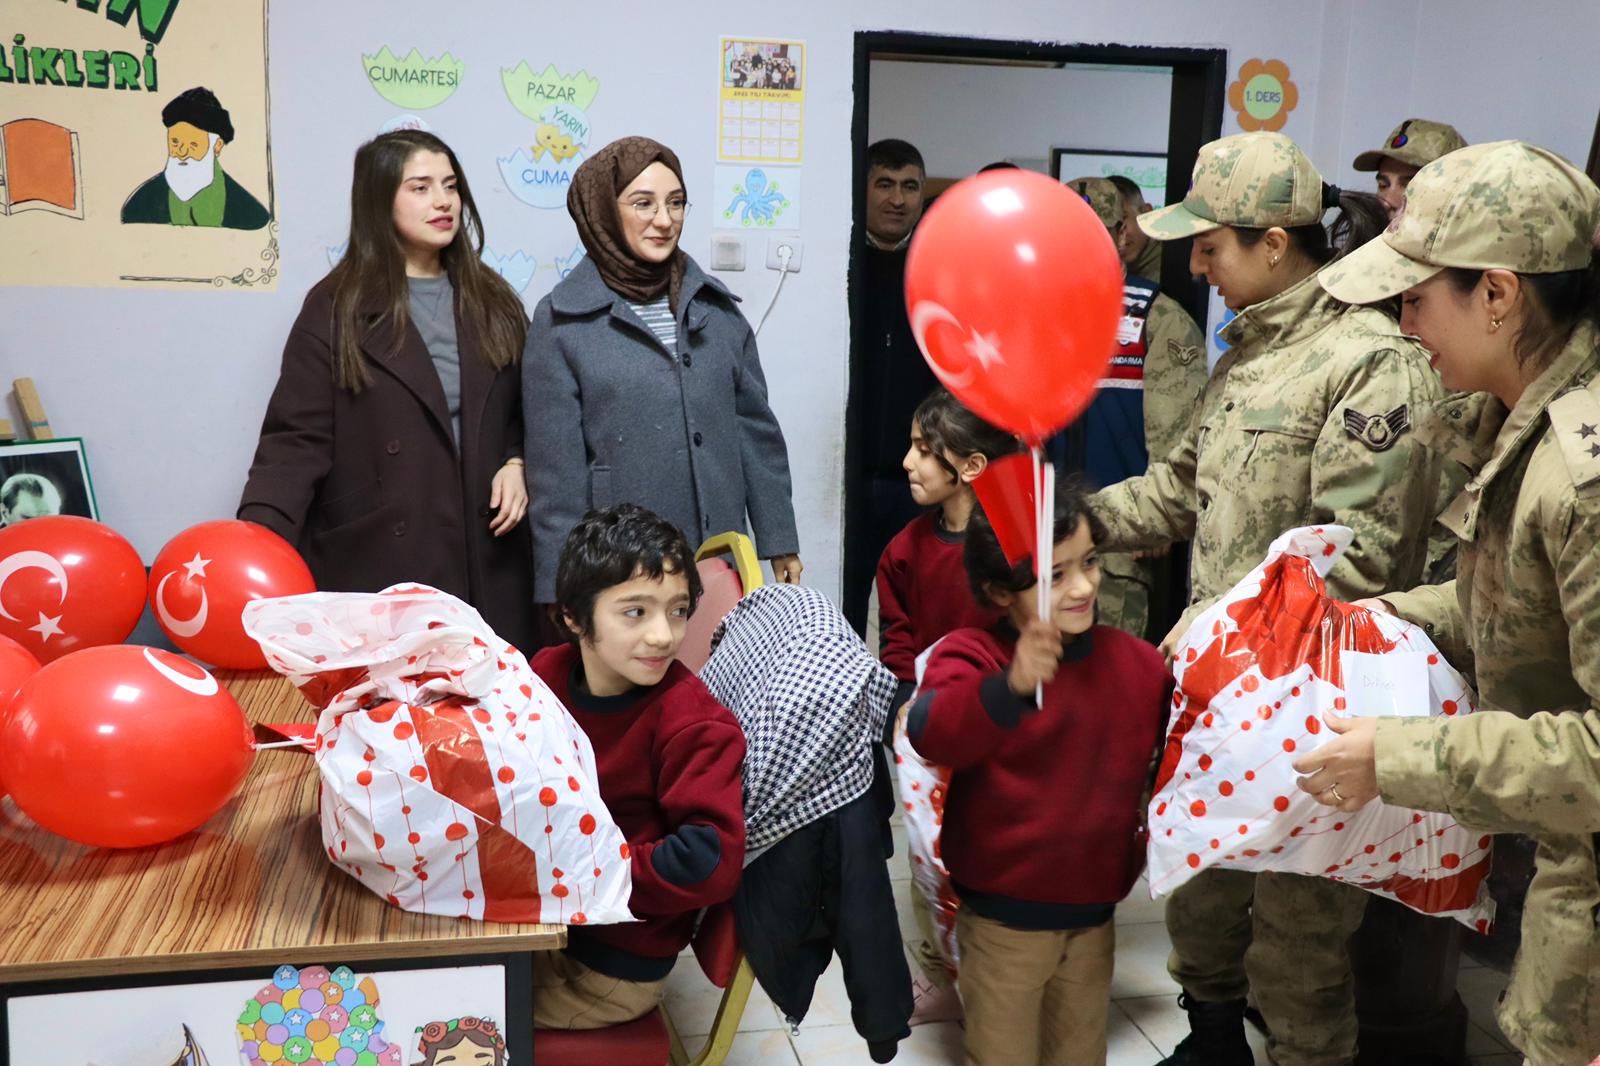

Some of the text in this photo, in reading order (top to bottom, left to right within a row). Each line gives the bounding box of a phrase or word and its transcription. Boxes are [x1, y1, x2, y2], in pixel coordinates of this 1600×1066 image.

[368, 65, 459, 88] CUMARTESİ
[526, 81, 576, 102] PAZAR
[1246, 90, 1281, 103] 1. DERS
[551, 105, 589, 139] YARIN
[521, 168, 570, 186] CUMA
